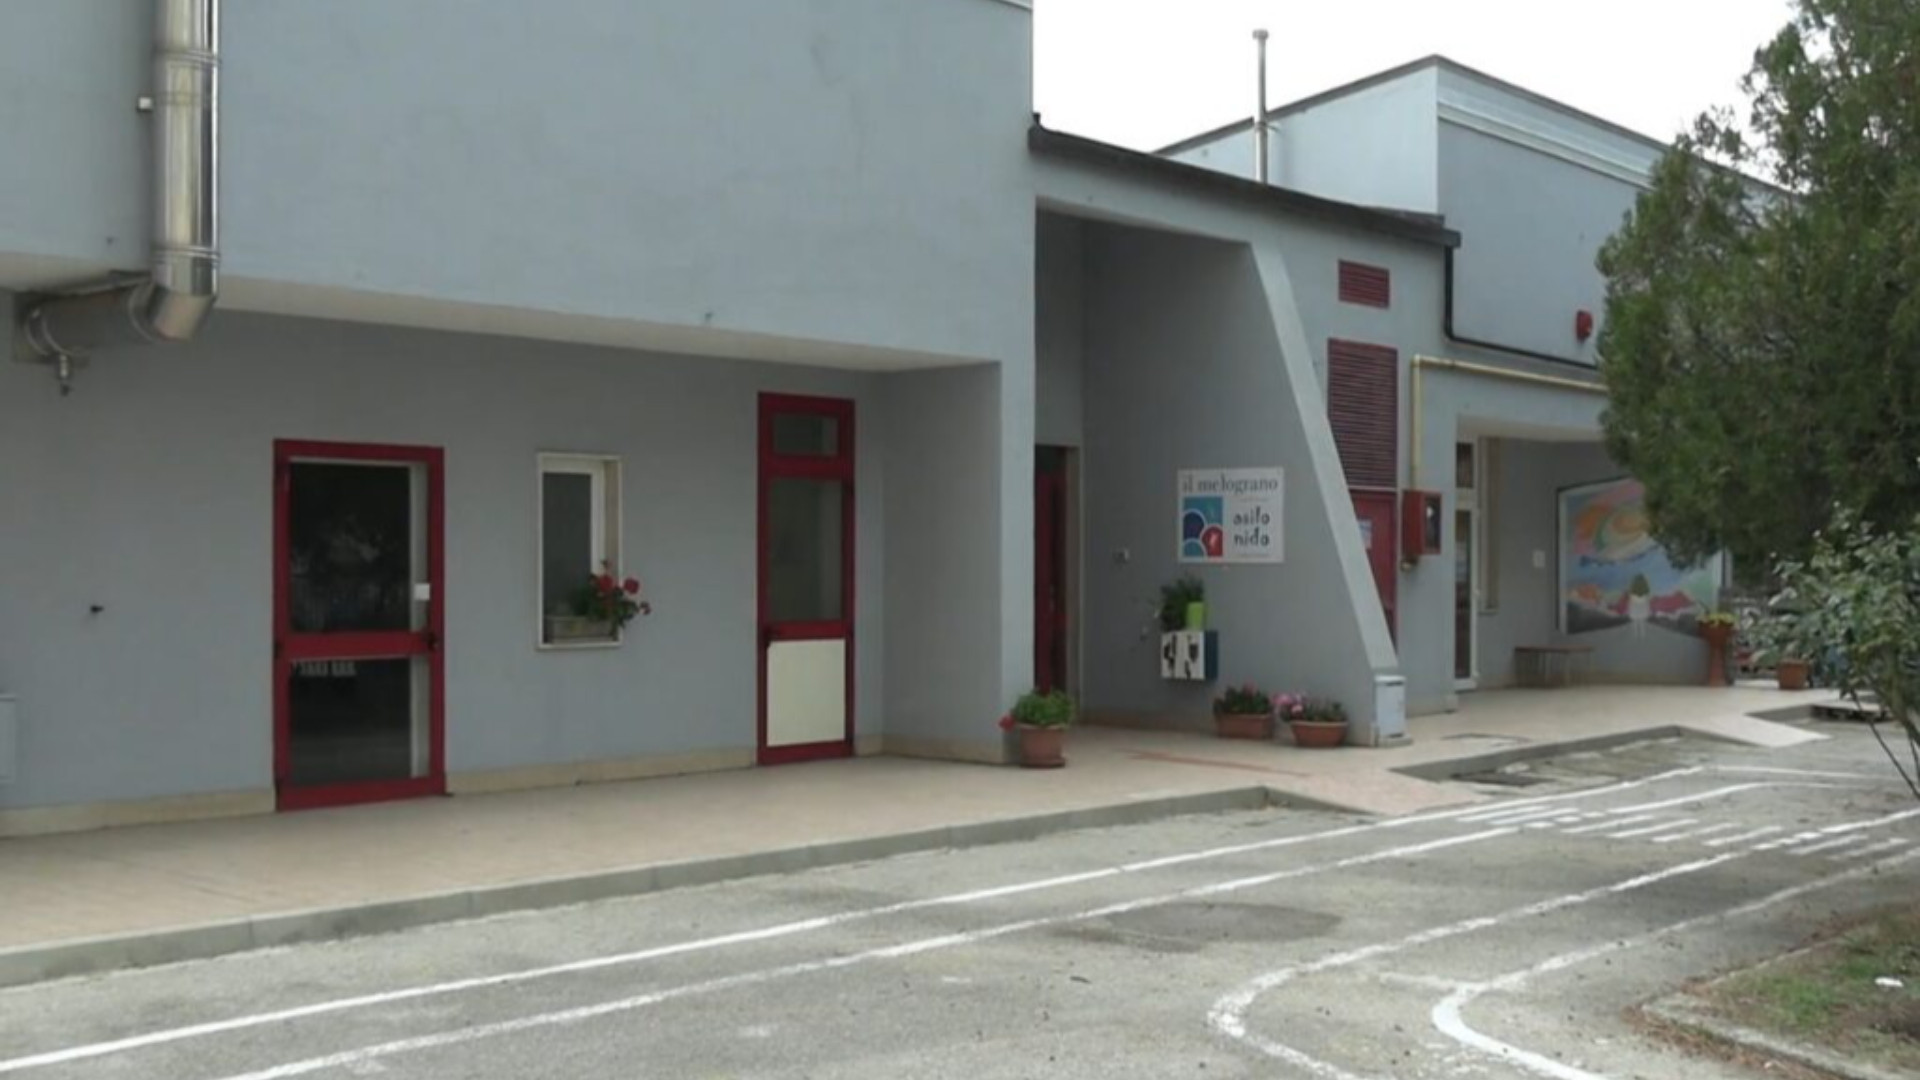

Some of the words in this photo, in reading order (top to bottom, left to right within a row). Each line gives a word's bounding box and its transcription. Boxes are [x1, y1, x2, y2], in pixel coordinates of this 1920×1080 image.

[1182, 474, 1194, 492] il
[1198, 474, 1278, 494] melograno
[1233, 527, 1270, 546] nido
